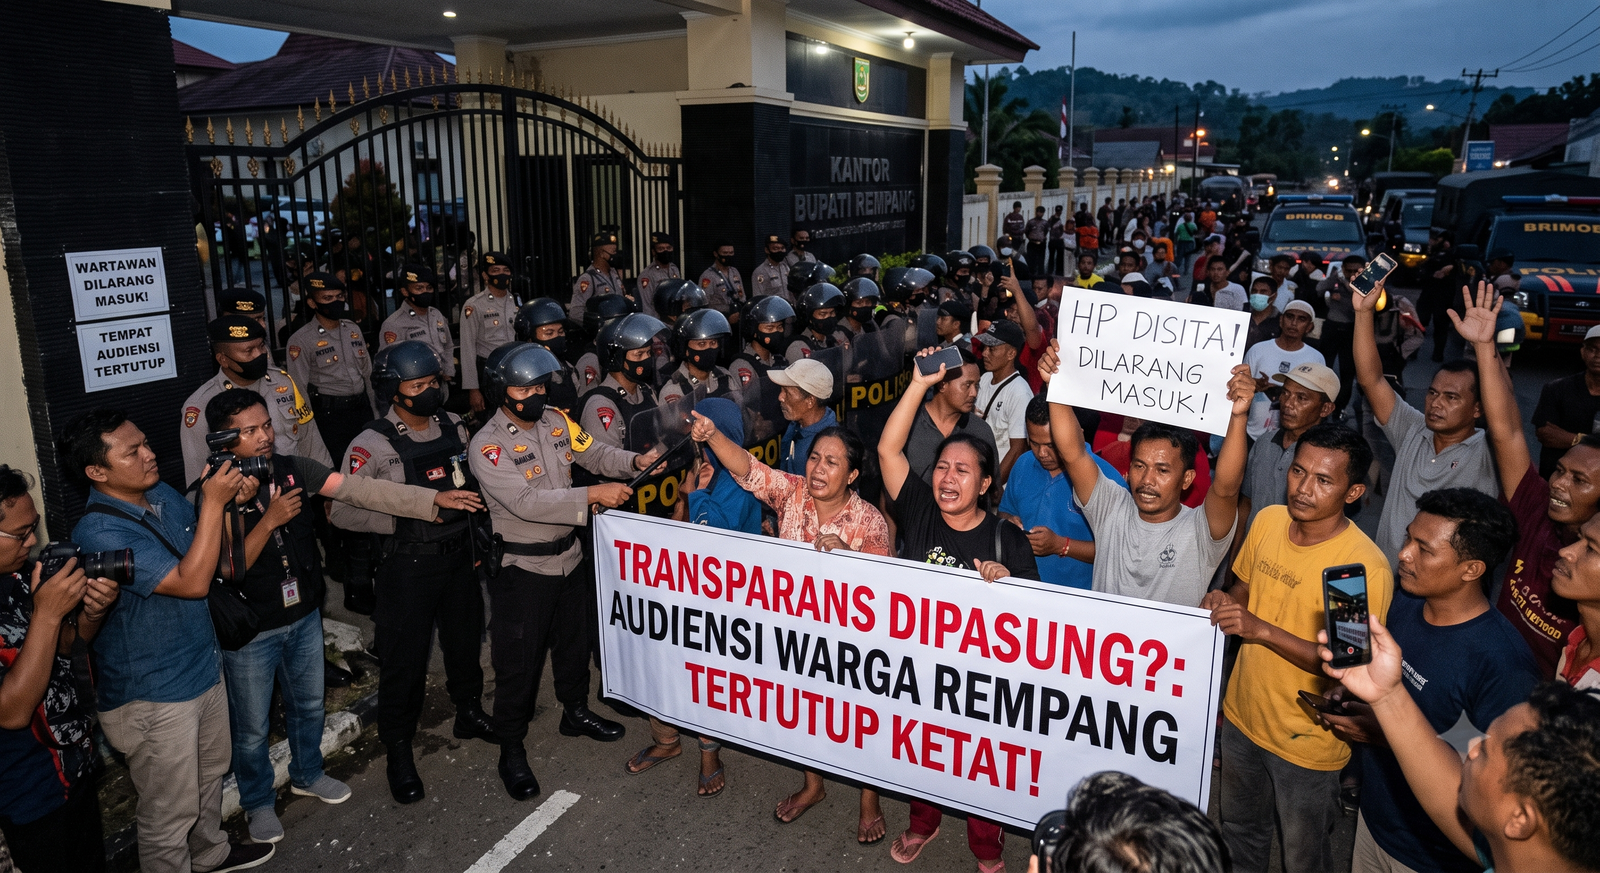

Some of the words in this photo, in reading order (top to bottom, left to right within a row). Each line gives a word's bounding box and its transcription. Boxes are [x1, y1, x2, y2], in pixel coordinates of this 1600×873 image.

[830, 156, 890, 182] KANTOR
[795, 192, 851, 221] BUPATI
[855, 190, 915, 216] REMPANG
[1285, 213, 1344, 221] BRIMOB
[75, 257, 157, 274] WARTAWAN
[84, 274, 154, 291] DILARANG
[95, 291, 149, 307] MASUK!
[99, 327, 153, 343] TEMPAT
[1071, 300, 1117, 338] HP
[1133, 311, 1241, 357] DISITA!
[97, 342, 160, 360] AUDIENSI
[94, 357, 165, 378] TERTUTUP
[1079, 346, 1204, 385] DILARANG
[614, 539, 877, 634] TRANSPARANS
[889, 590, 1186, 698] DIPASUNG?:
[609, 589, 764, 666] AUDIENSI
[773, 625, 921, 706] WARGA
[933, 662, 1179, 765] REMPANG
[684, 660, 881, 750] TERTUTUP
[891, 714, 1043, 798] KETAT!
